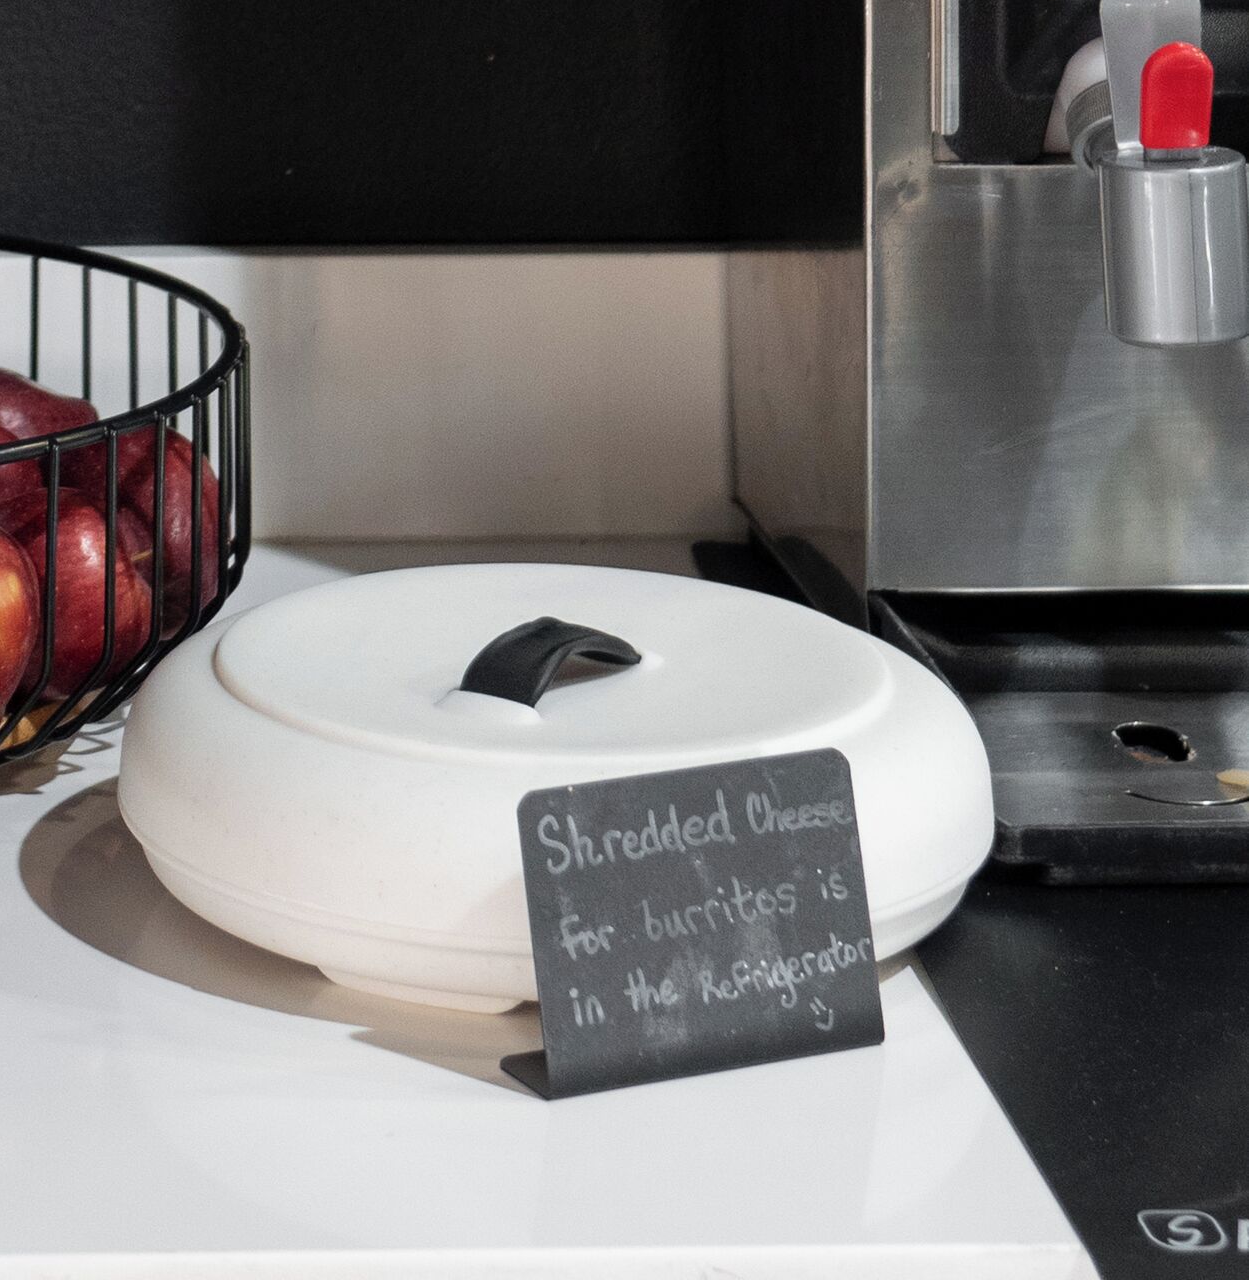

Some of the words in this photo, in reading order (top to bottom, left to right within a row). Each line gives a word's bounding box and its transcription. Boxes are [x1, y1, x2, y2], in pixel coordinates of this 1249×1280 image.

[537, 789, 736, 875] Shredded
[746, 791, 853, 835] Cheese
[641, 875, 797, 942] burritos
[817, 868, 849, 901] is
[568, 988, 606, 1028] in
[624, 967, 679, 1012] the
